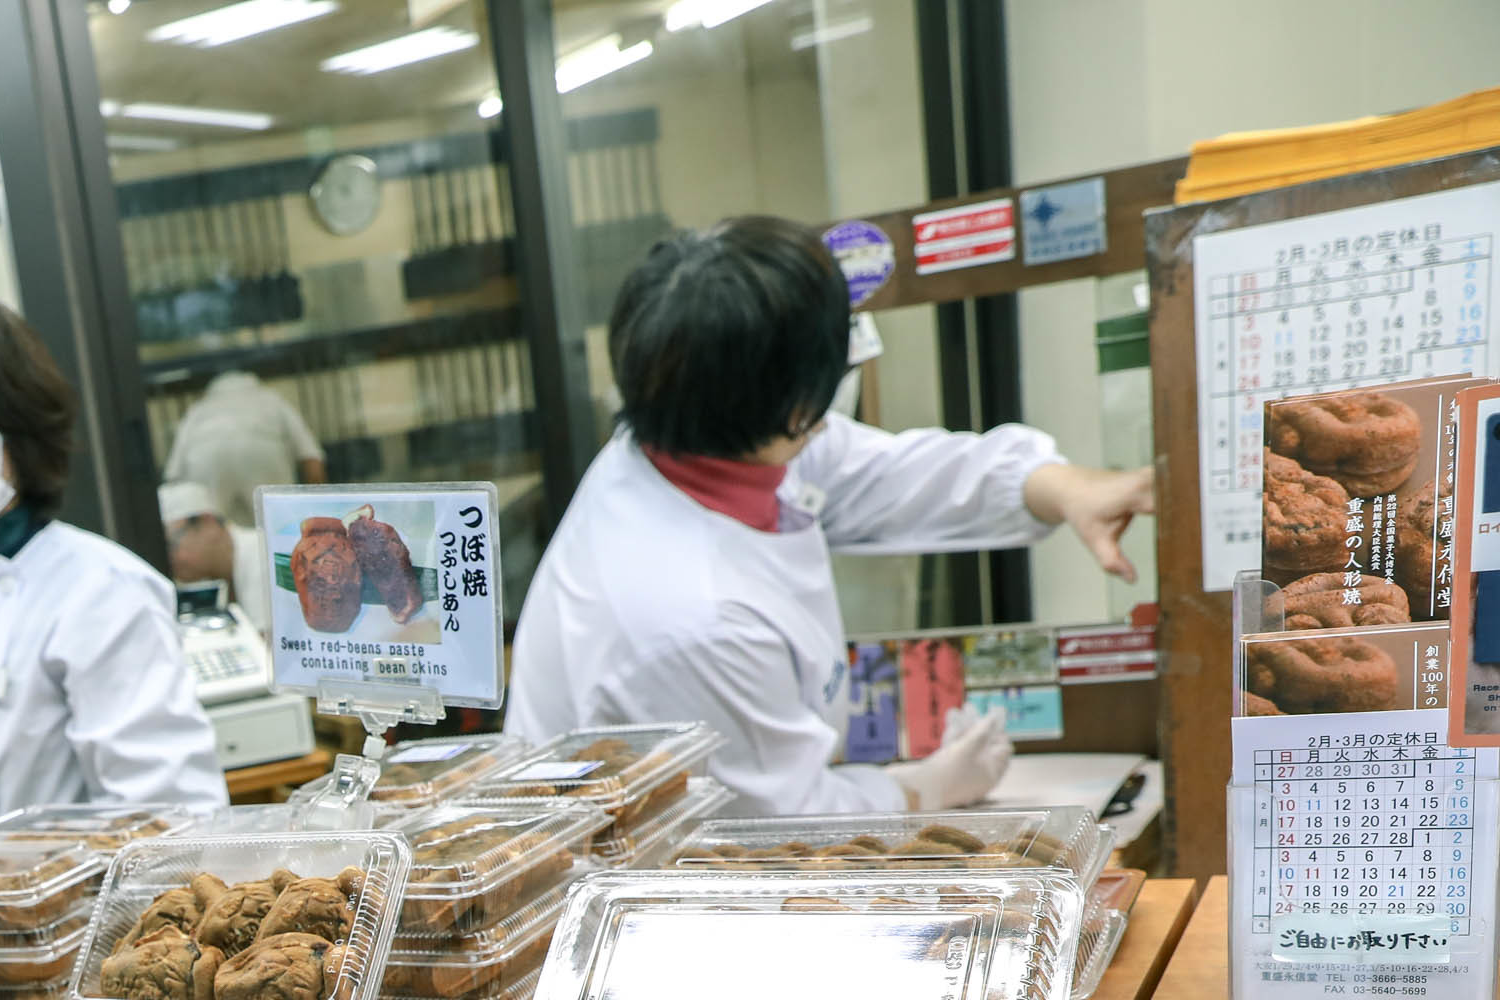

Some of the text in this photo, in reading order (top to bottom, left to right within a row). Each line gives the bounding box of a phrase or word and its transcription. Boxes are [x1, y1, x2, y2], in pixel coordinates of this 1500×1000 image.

[1459, 305, 1481, 321] 16
[459, 506, 488, 597] つぼ焼
[1342, 497, 1365, 606] 重盛の人形焼
[440, 531, 459, 632] つぶしあん
[281, 637, 312, 652] Sweet
[389, 643, 424, 657] paste
[301, 656, 447, 676] containing bean skins
[1420, 645, 1444, 706] 創業100年の
[1308, 732, 1438, 748] 2月・3月の定休日
[1281, 752, 1291, 762] 日
[1308, 751, 1320, 762] 月
[1335, 750, 1349, 762] 火
[1364, 748, 1379, 760] 水
[1393, 747, 1408, 760] 木
[1422, 746, 1438, 759] 金
[1278, 763, 1464, 777] 27 28 29 30 31 1 2
[1283, 784, 1290, 794] 3
[1310, 783, 1317, 794] 4
[1338, 782, 1346, 793] 5
[1367, 782, 1375, 792] 6
[1396, 781, 1404, 792] 7
[1425, 780, 1433, 791] 8
[1279, 797, 1468, 811] 10 11 12 13 14 15 16
[1279, 815, 1468, 828] 17 18 19 20 21 22 23
[1278, 833, 1462, 845] 24 25 26 27 28 1 2
[1282, 850, 1461, 862] 3 4 5 6 7 8 9
[1279, 868, 1466, 879] 10 11 12 13 14 15 16
[1305, 886, 1320, 896] 18
[1333, 886, 1349, 896] 19
[1360, 886, 1377, 896] 20
[1388, 886, 1404, 896] 21
[1417, 886, 1435, 897] 22
[1447, 886, 1465, 897] 23
[1451, 921, 1459, 931] 6
[1279, 929, 1448, 951] ご自由にお取り下さい
[1261, 971, 1427, 984] 重盛永信堂 TEL 03-3666-5885
[1324, 985, 1427, 996] FAX 03-5640-5699
